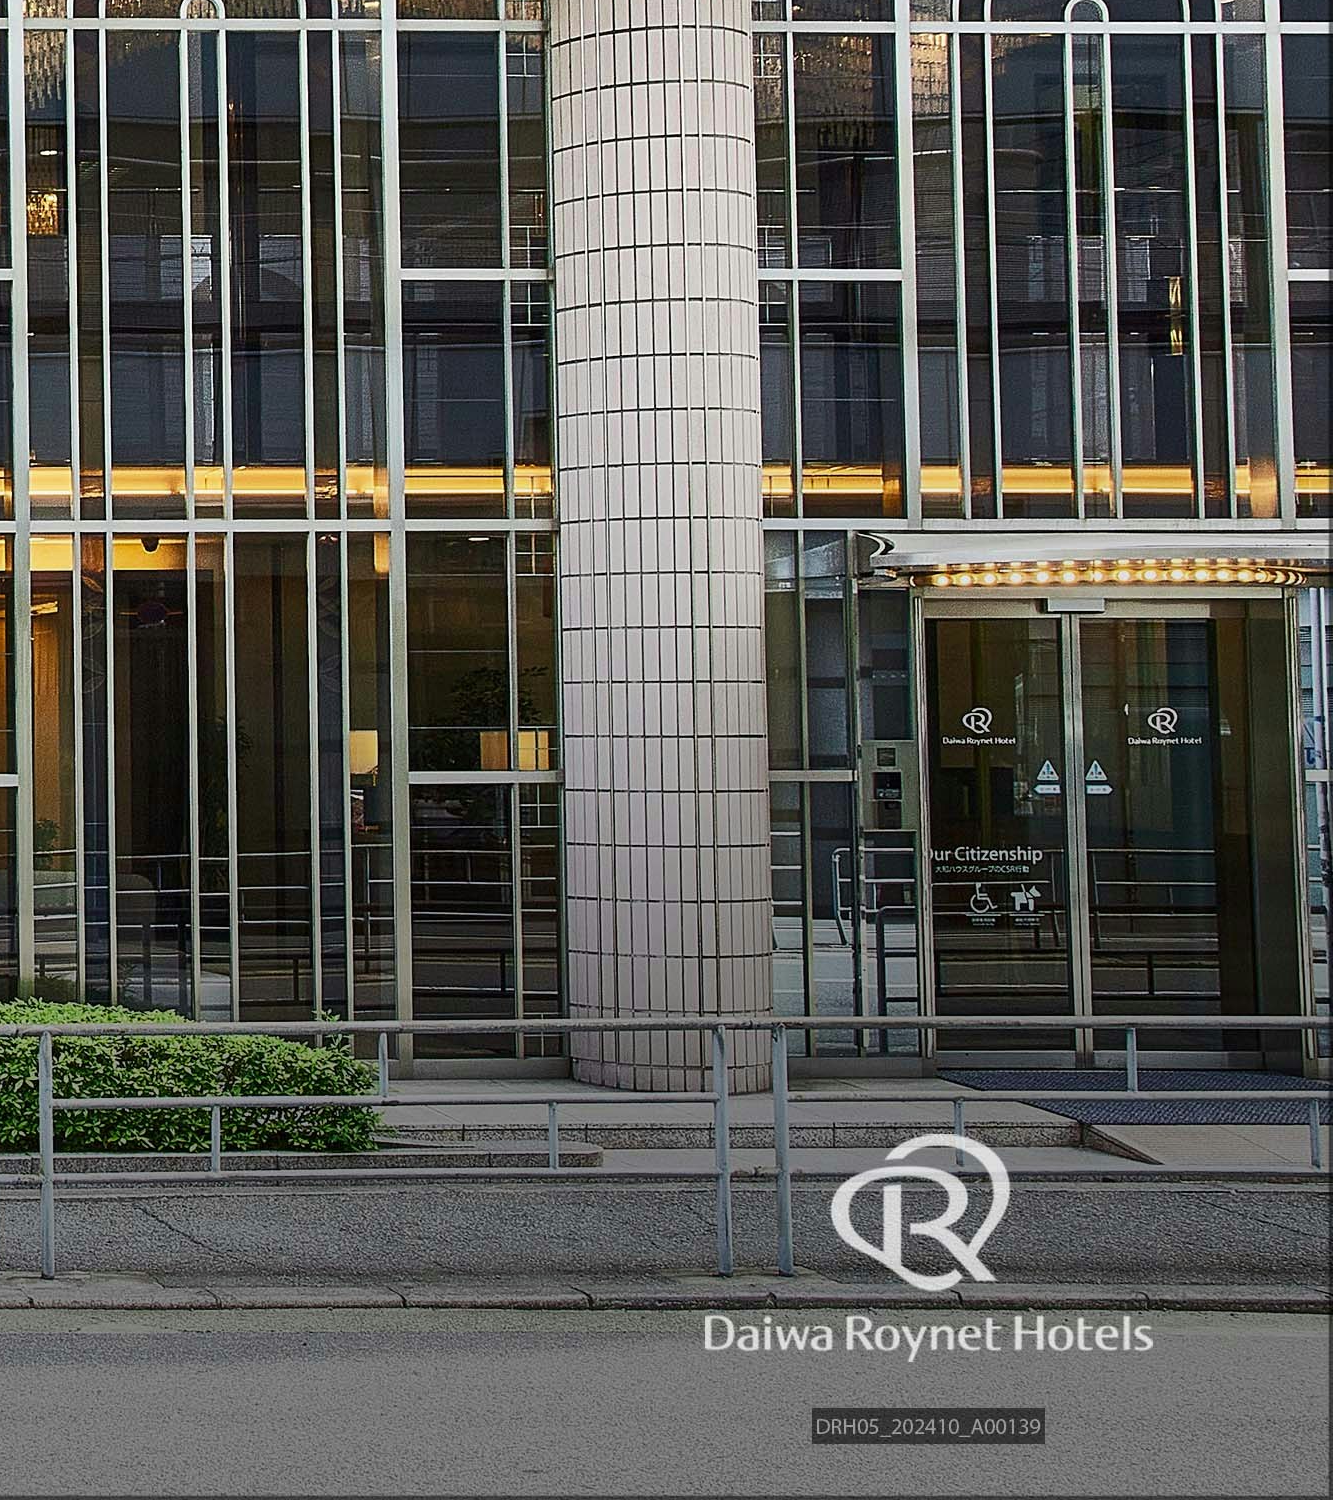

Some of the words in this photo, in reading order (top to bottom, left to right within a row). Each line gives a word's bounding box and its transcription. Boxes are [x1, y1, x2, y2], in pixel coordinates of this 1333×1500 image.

[942, 736, 966, 745] Daiwa
[966, 736, 993, 746] Roynet
[994, 736, 1016, 745] Hotel
[1128, 736, 1151, 745] Daiwa
[1152, 736, 1179, 746] Roynet
[1180, 736, 1202, 745] Hotel
[930, 848, 951, 861] ur
[954, 845, 1043, 865] Citizenship
